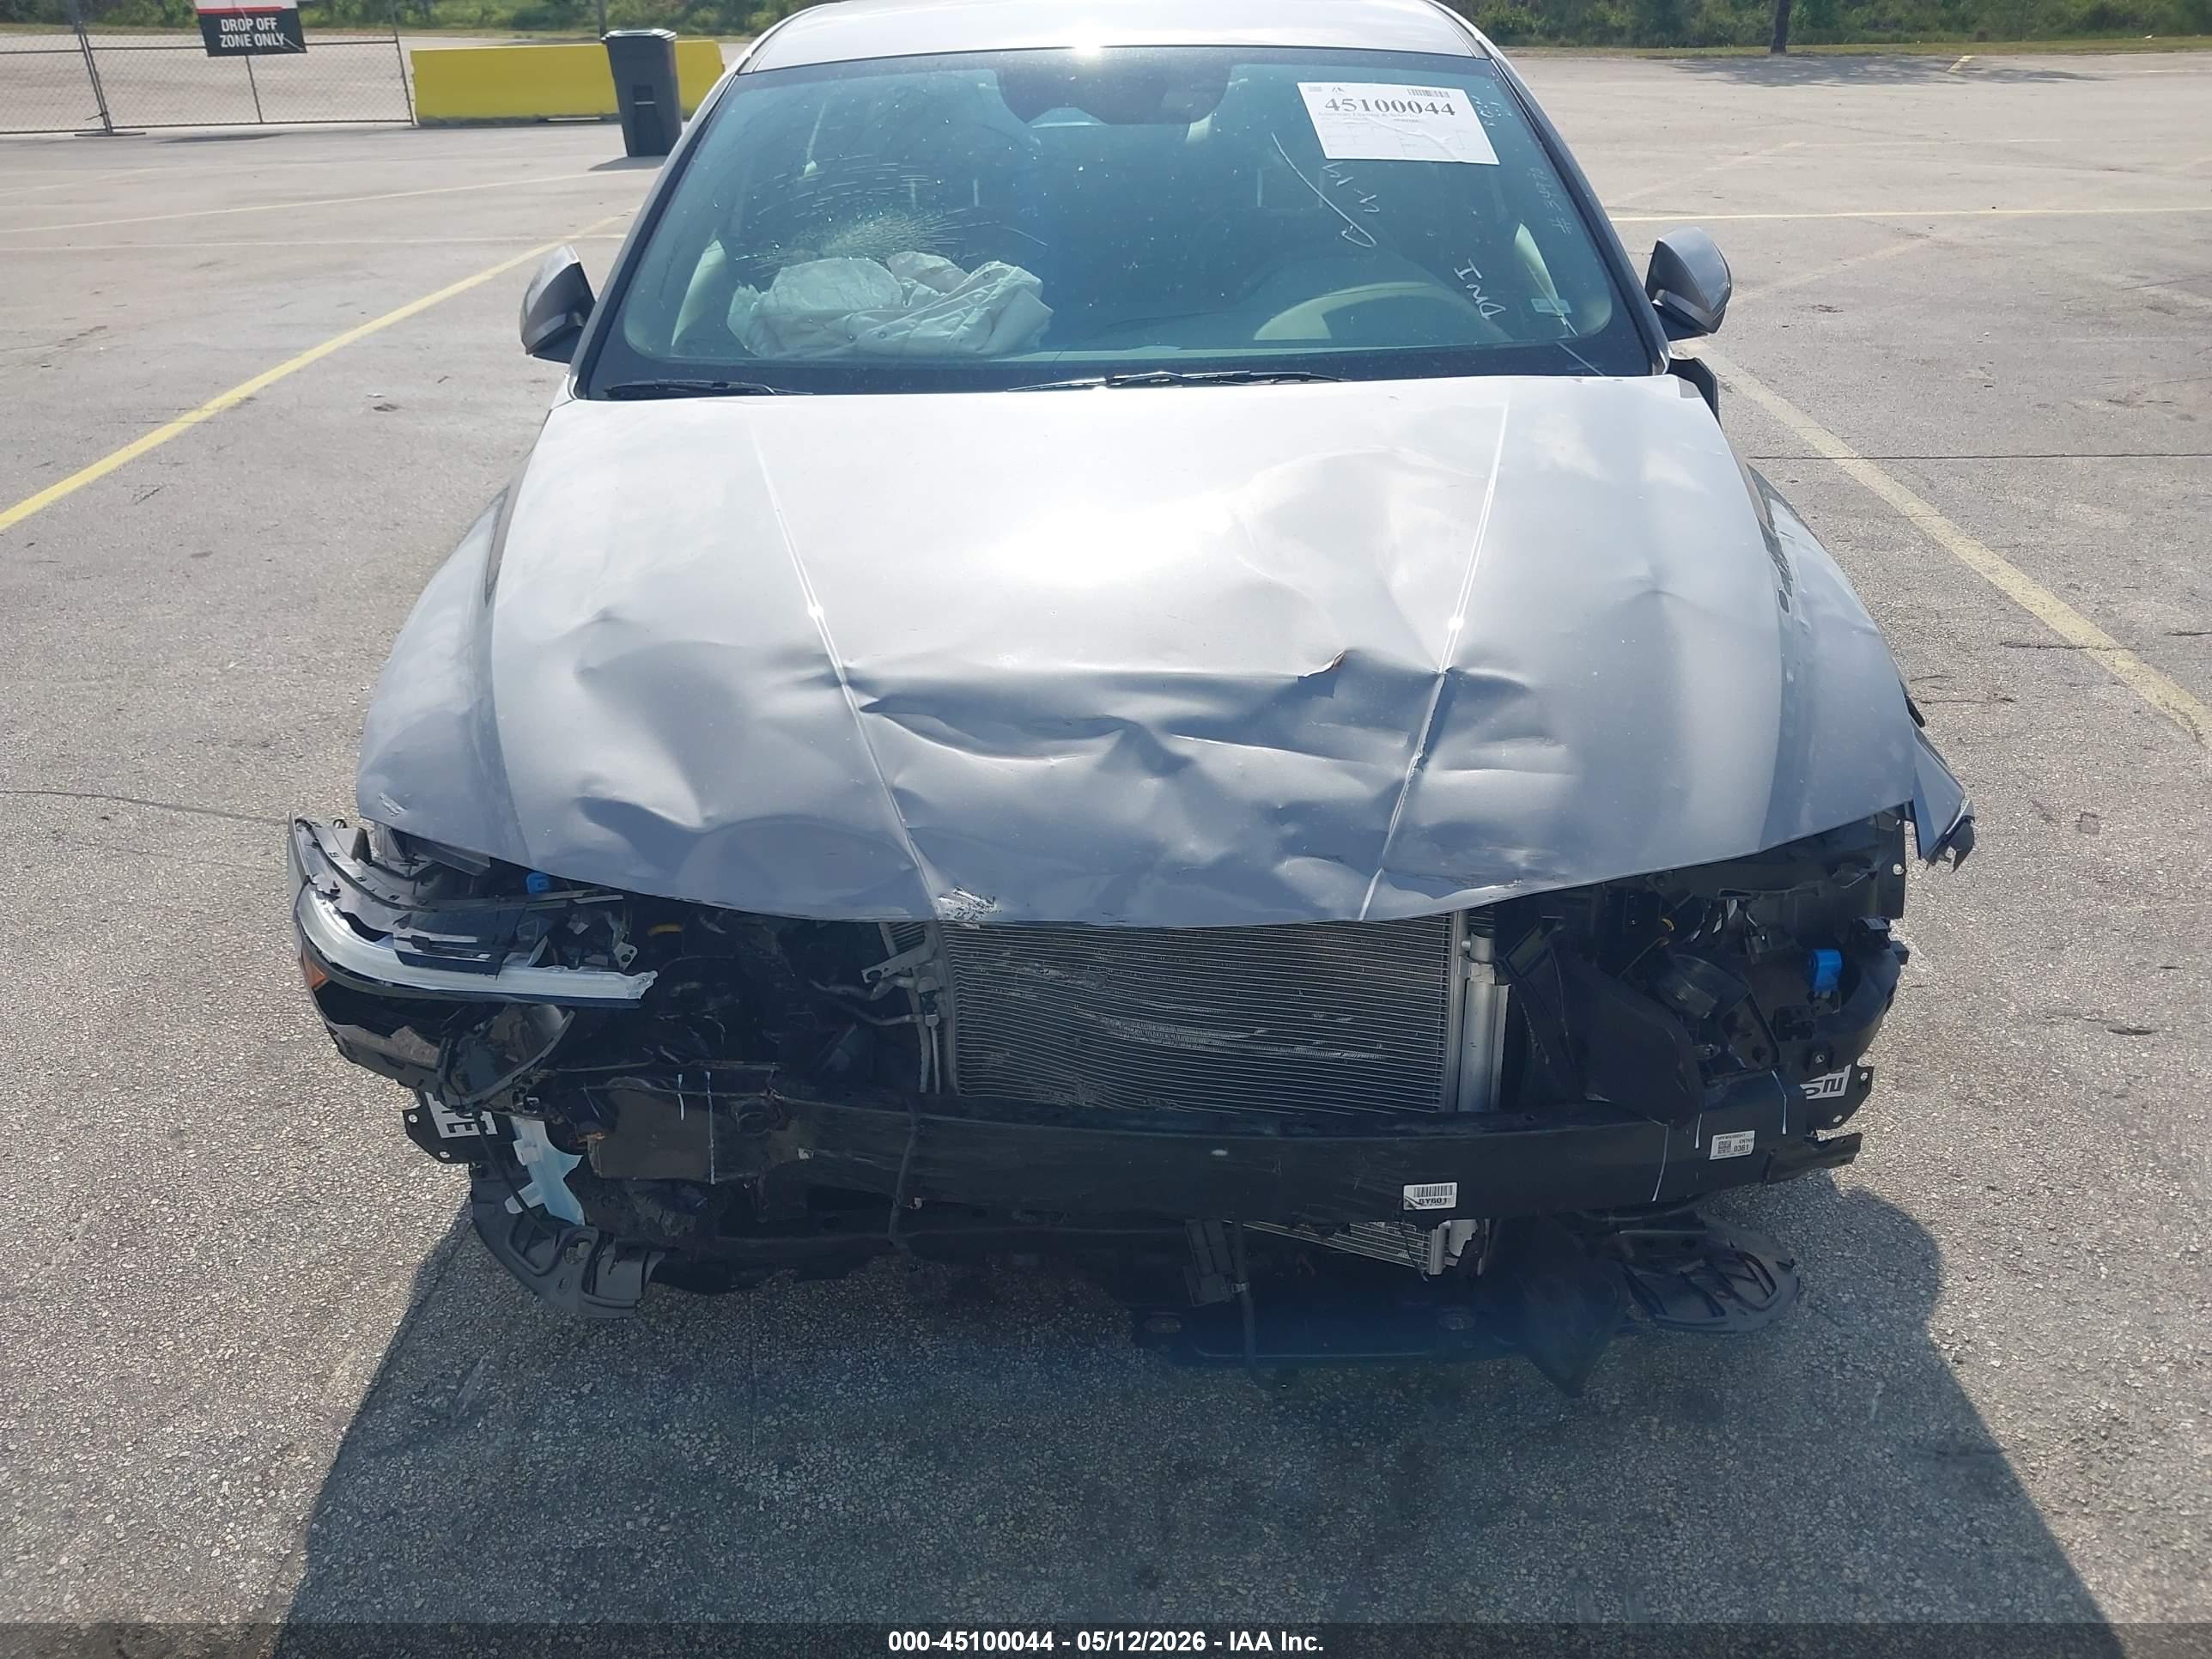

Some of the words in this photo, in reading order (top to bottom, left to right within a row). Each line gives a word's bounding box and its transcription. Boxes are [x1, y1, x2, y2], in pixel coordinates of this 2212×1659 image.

[221, 18, 254, 32] DROP
[257, 17, 278, 31] OFF
[219, 34, 252, 47] ZONE
[254, 33, 285, 46] ONLY
[1324, 98, 1455, 116] 45100044
